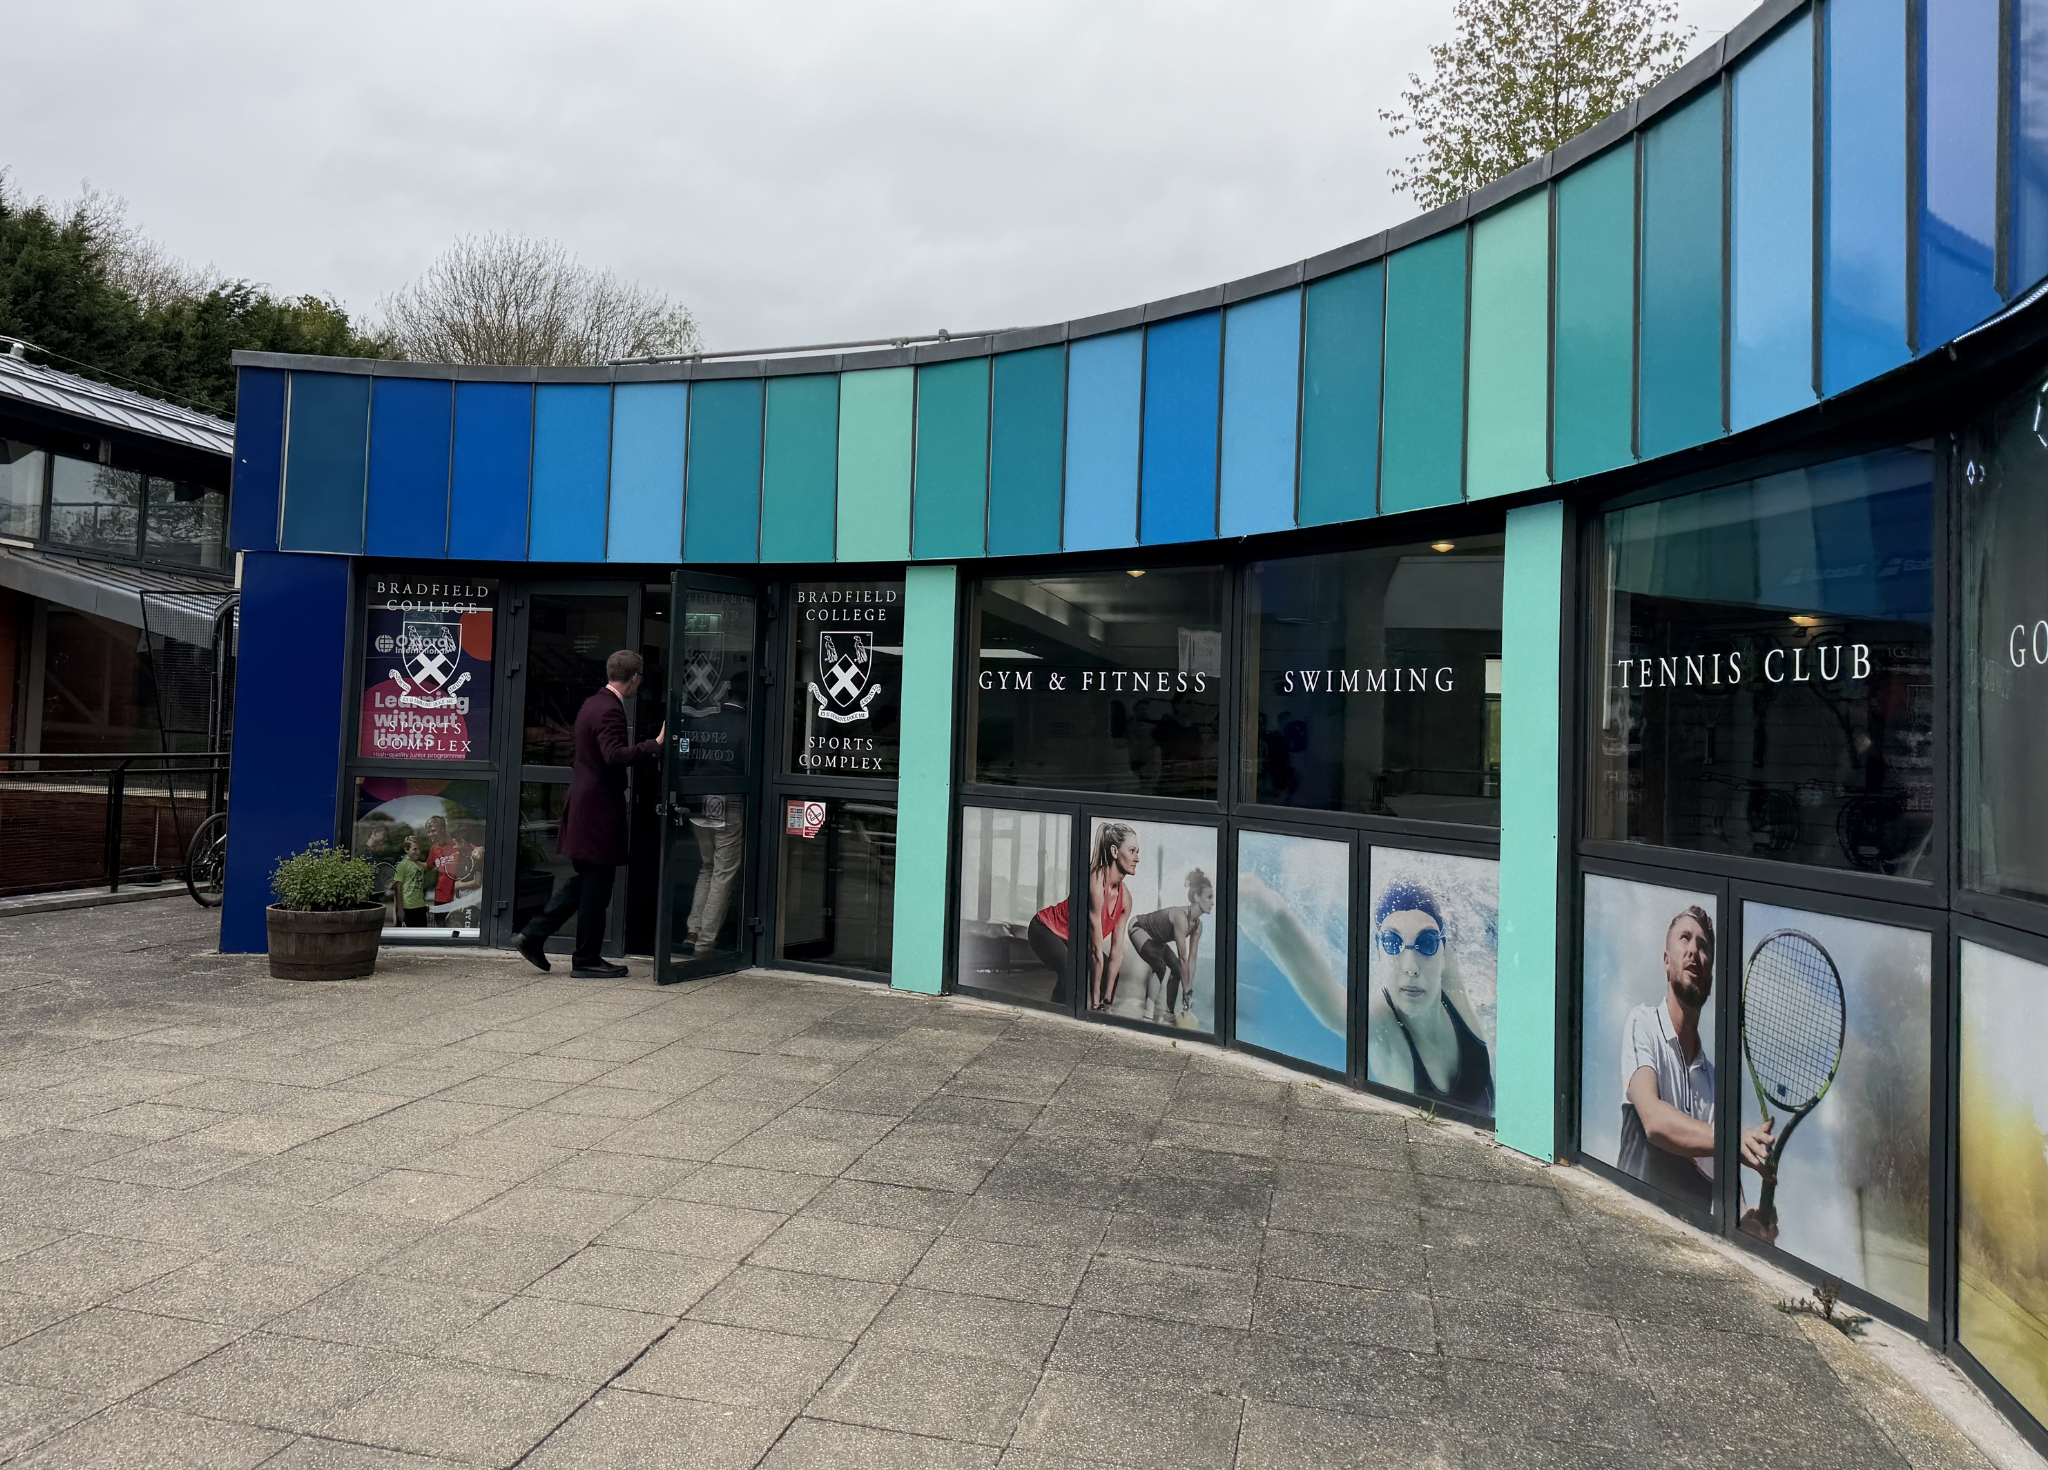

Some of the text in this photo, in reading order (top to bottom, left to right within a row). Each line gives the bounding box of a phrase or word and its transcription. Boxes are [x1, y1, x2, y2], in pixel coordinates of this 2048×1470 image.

[377, 582, 489, 597] BRADFIELD
[798, 590, 897, 603] BRADFIELD
[387, 600, 477, 614] COLLEGE
[806, 608, 887, 621] COLLEGE
[2009, 620, 2048, 668] GO
[1618, 643, 1871, 689] TENNIS CLUB
[978, 670, 1207, 693] GYM & FITNESS
[1284, 666, 1455, 693] SWIMMING
[374, 709, 458, 728] without
[388, 720, 462, 735] SPORTS
[373, 728, 435, 747] limits
[377, 737, 472, 752] COMPLEX
[809, 736, 873, 751] SPORTS
[799, 754, 882, 770] COMPLEX
